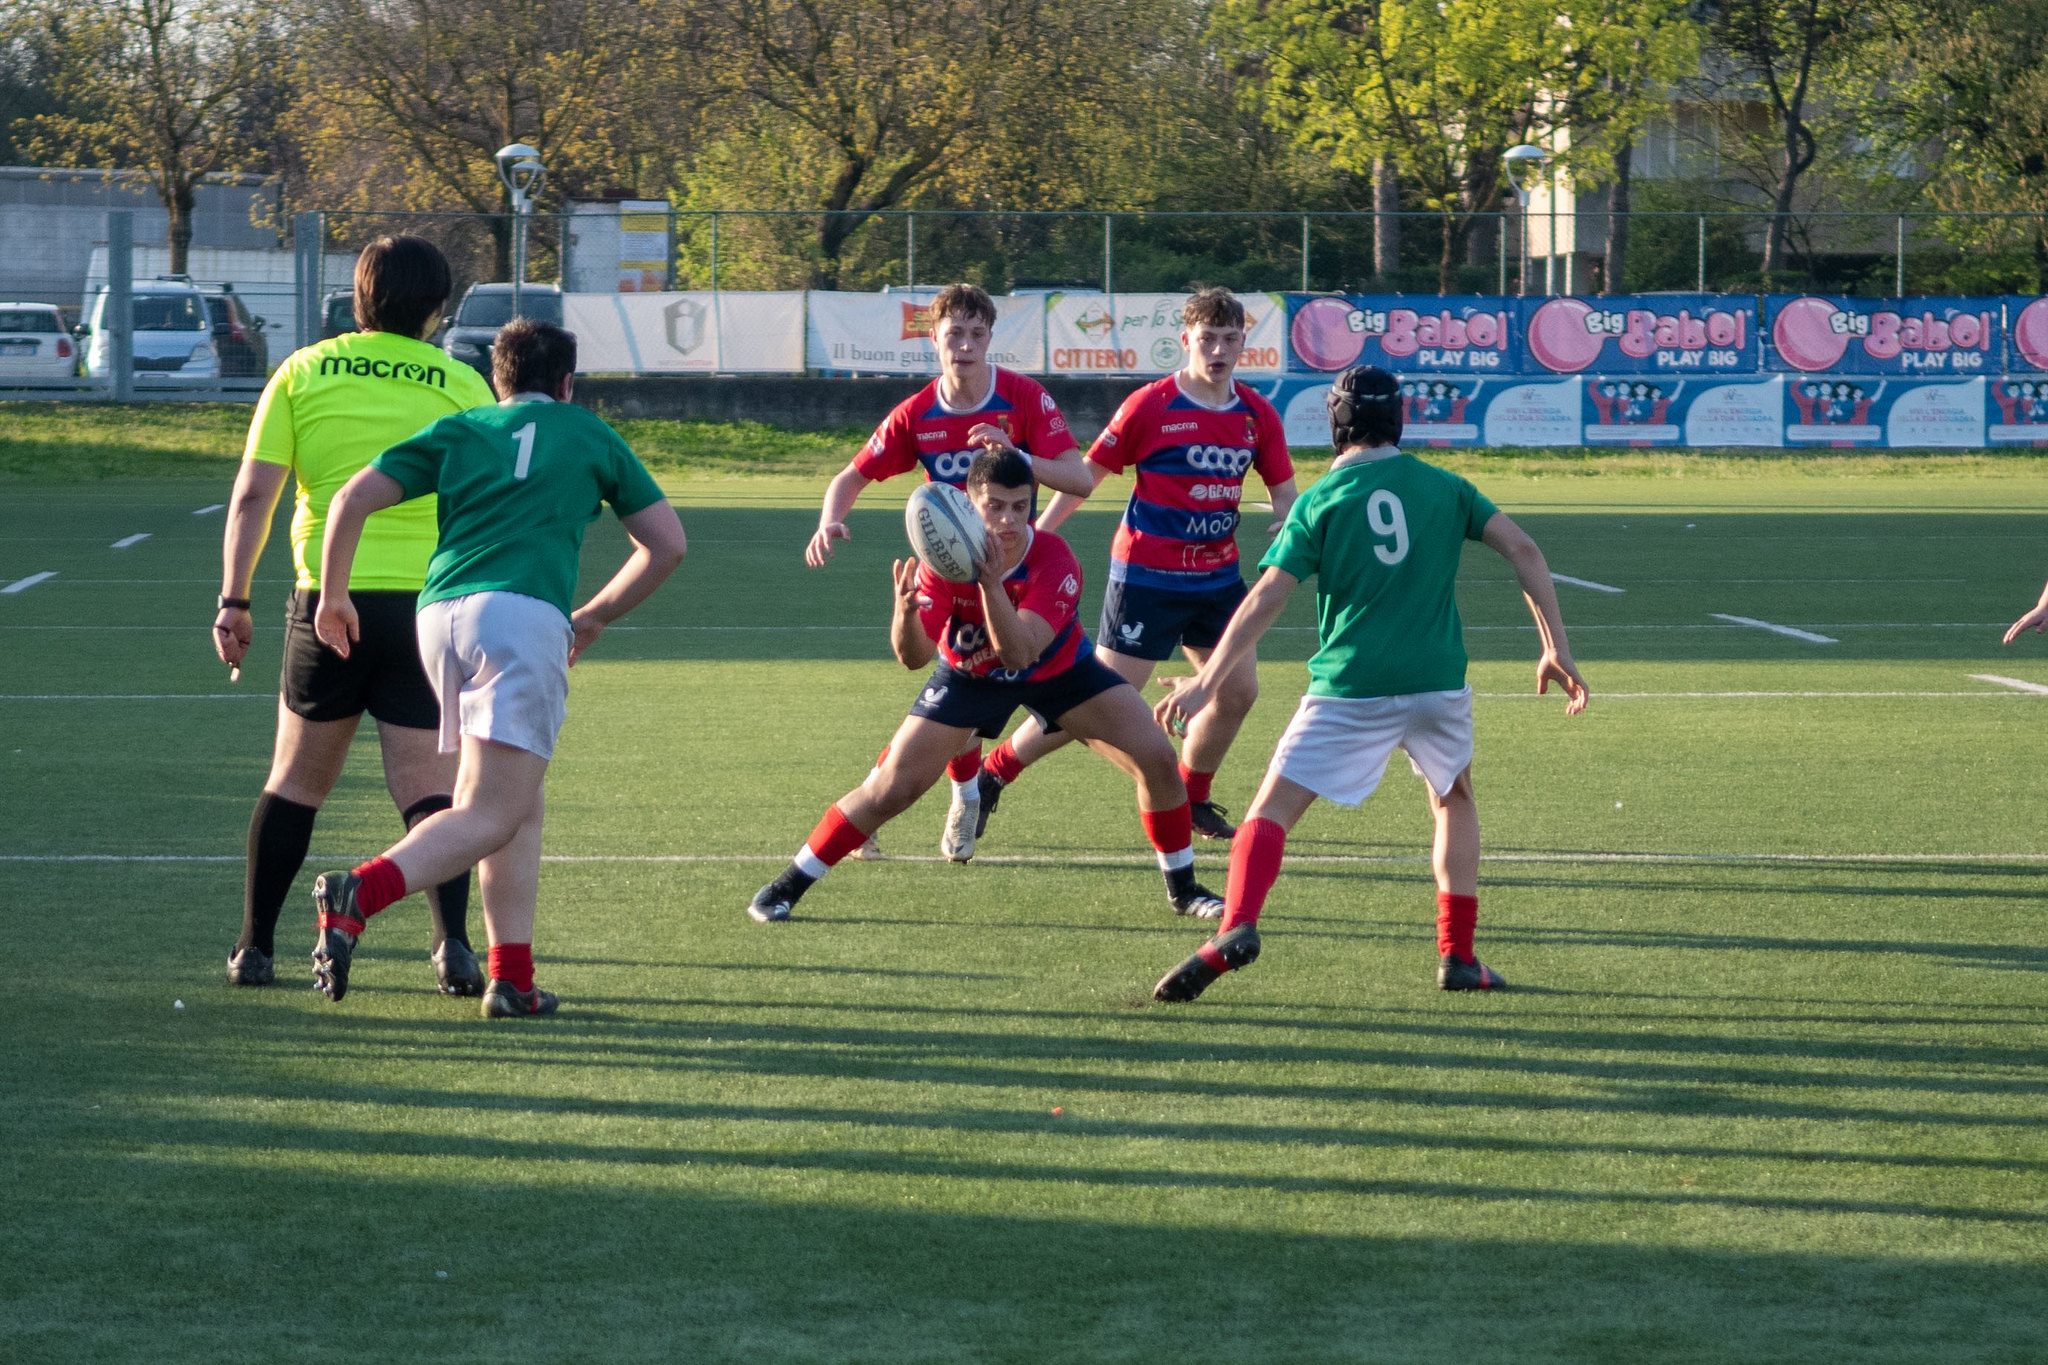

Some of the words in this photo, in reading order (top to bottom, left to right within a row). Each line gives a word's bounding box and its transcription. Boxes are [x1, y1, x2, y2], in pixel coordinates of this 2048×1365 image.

[1120, 315, 1149, 331] per
[1347, 309, 1387, 333] Big
[1381, 308, 1508, 357] Babol
[1584, 310, 1625, 335] Big
[1618, 308, 1746, 358] Babol
[1830, 310, 1869, 335] Big
[1863, 310, 1990, 359] Babol
[851, 344, 895, 361] buon
[1053, 348, 1137, 368] CITTERIO
[1419, 350, 1465, 366] PLAY
[1469, 351, 1500, 367] BIG
[1657, 351, 1704, 367] PLAY
[1708, 351, 1739, 367] BIG
[1901, 352, 1948, 368] PLAY
[1952, 352, 1983, 368] BIG
[320, 356, 446, 388] macron
[511, 421, 536, 479] 1
[918, 507, 967, 578] GILBERT
[1366, 489, 1409, 565] 9
